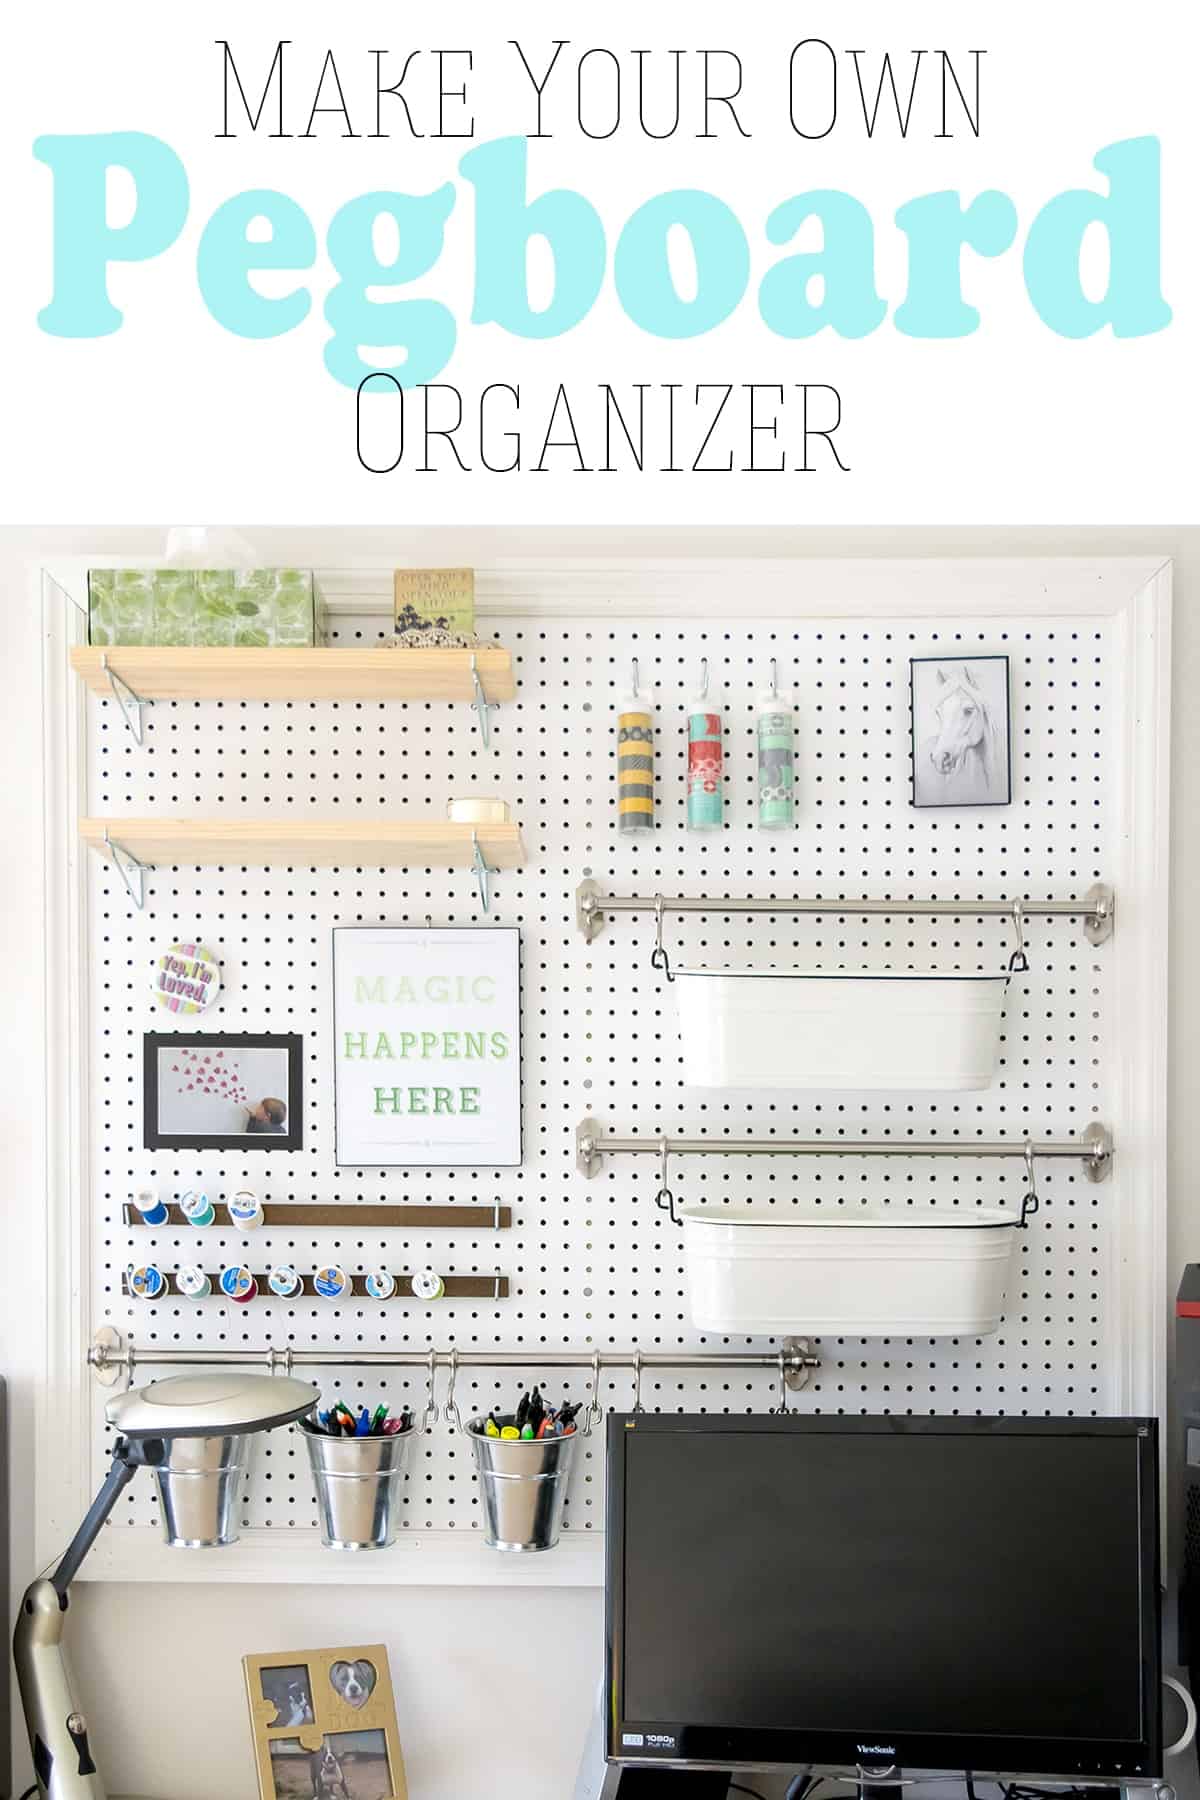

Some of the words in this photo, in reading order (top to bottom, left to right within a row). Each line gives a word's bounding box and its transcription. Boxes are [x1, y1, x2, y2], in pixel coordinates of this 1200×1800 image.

[160, 972, 206, 1004] Loved.
[354, 976, 496, 1003] MAGIC
[344, 1031, 509, 1060] HAPPENS
[373, 1087, 481, 1115] HERE
